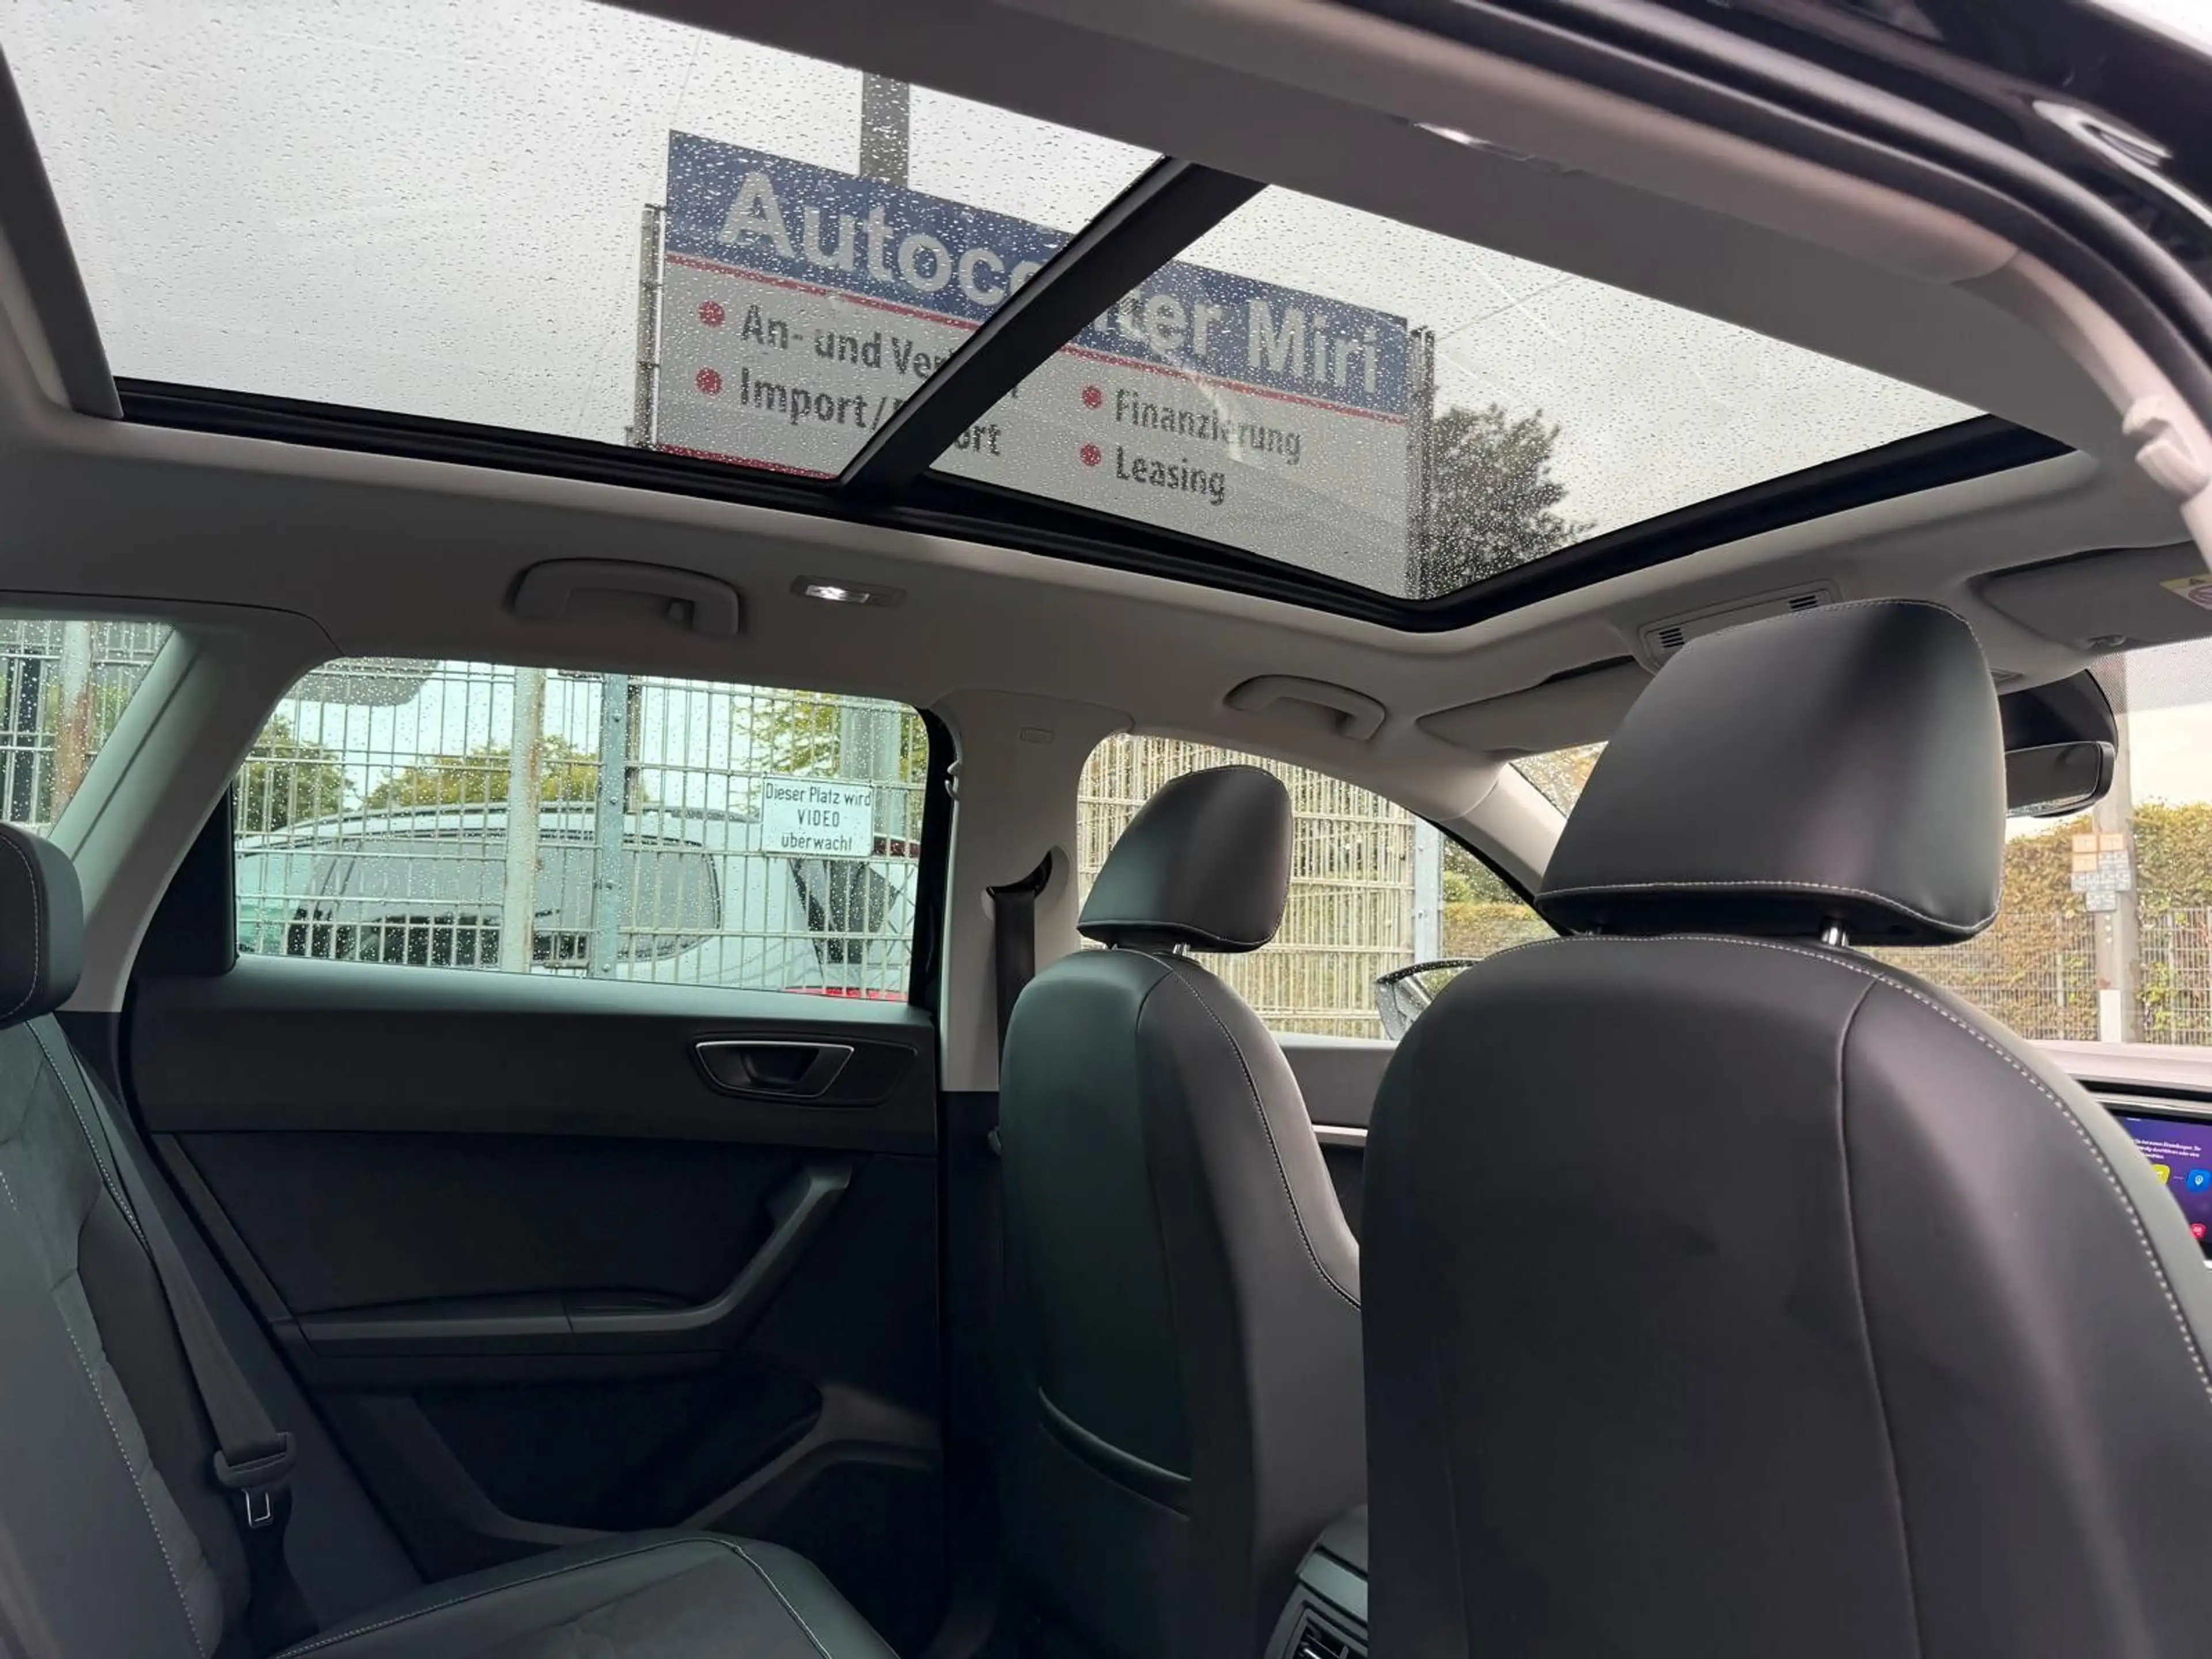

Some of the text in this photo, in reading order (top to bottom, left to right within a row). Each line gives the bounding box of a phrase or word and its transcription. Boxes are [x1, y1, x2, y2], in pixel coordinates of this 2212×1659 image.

[720, 171, 1377, 393] Autocter Miri
[740, 304, 804, 350] An-
[815, 331, 882, 369] und
[741, 366, 1001, 456] Import/ort
[1116, 446, 1225, 506] Leasing
[766, 782, 871, 806] Dieser Platz wird
[797, 809, 840, 828] VIDEO
